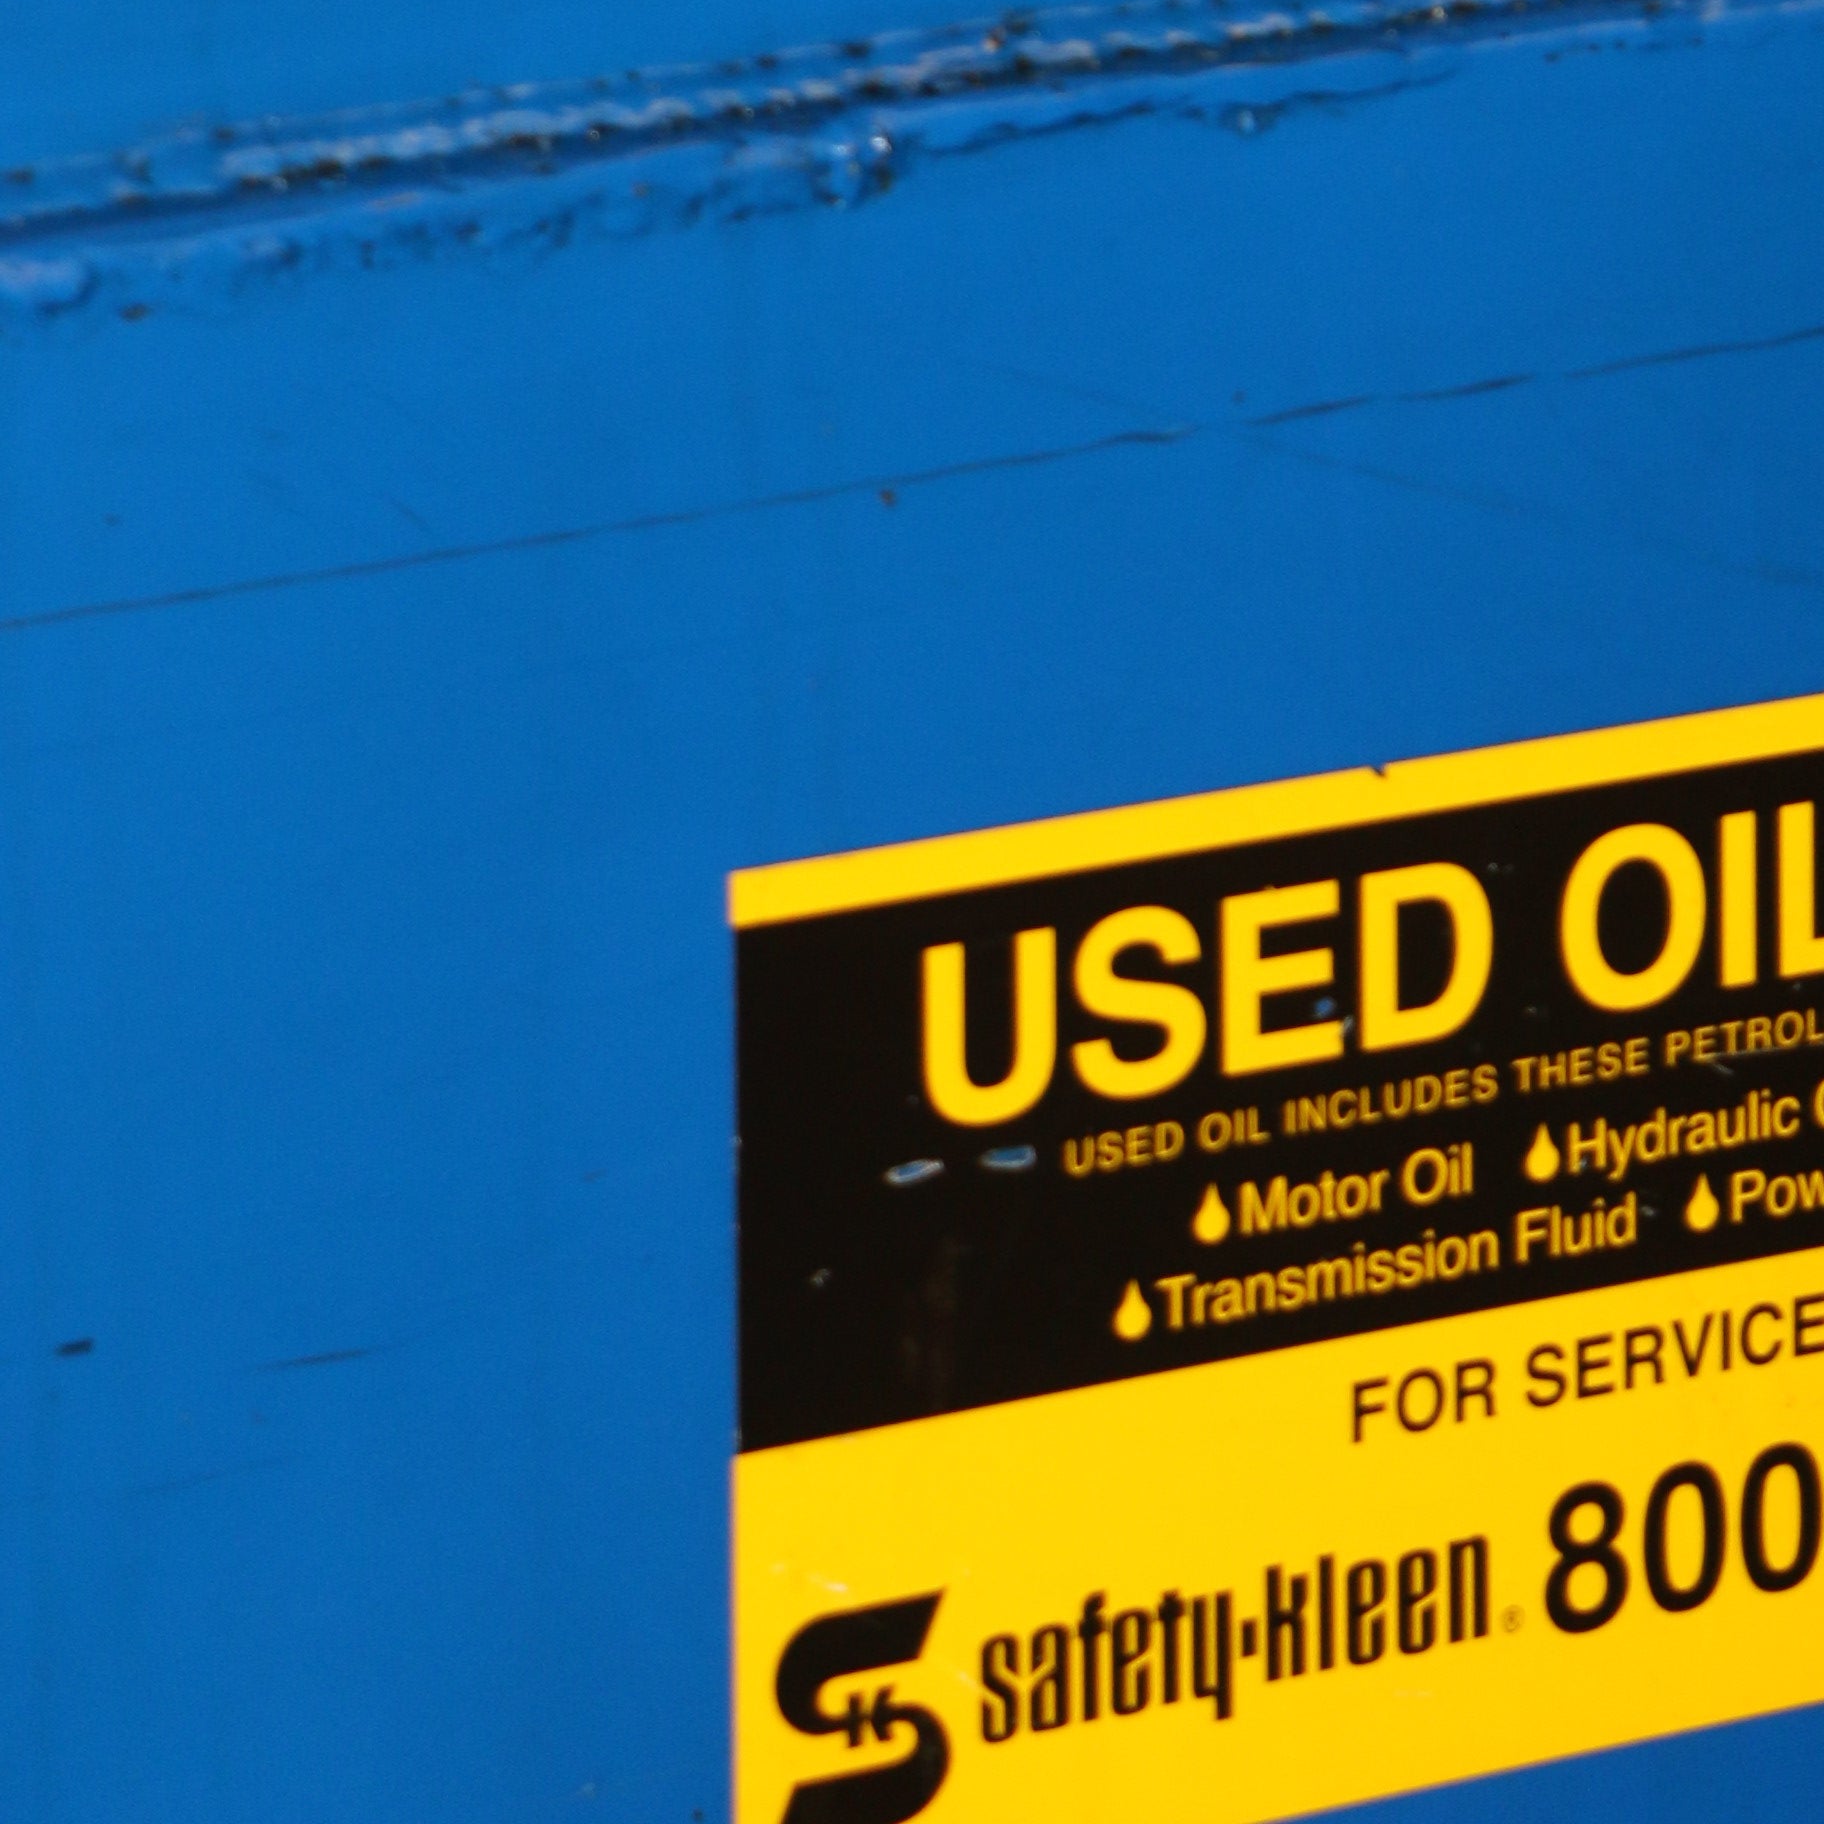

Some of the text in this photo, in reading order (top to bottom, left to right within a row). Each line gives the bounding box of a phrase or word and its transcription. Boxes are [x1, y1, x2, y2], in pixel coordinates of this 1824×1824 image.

[919, 861, 1497, 1133] USED
[1064, 1120, 1184, 1176] USED
[1198, 1106, 1270, 1152] OIL
[1284, 1063, 1498, 1134] INCLUDES
[1511, 1036, 1650, 1092] THESE
[1239, 1169, 1389, 1235] Motor
[1402, 1142, 1473, 1206] Oil
[1567, 1089, 1800, 1181] Hydraulic
[1155, 1229, 1499, 1329] Transmission
[1516, 1191, 1637, 1263] Fluid
[1352, 1360, 1496, 1442] FOR
